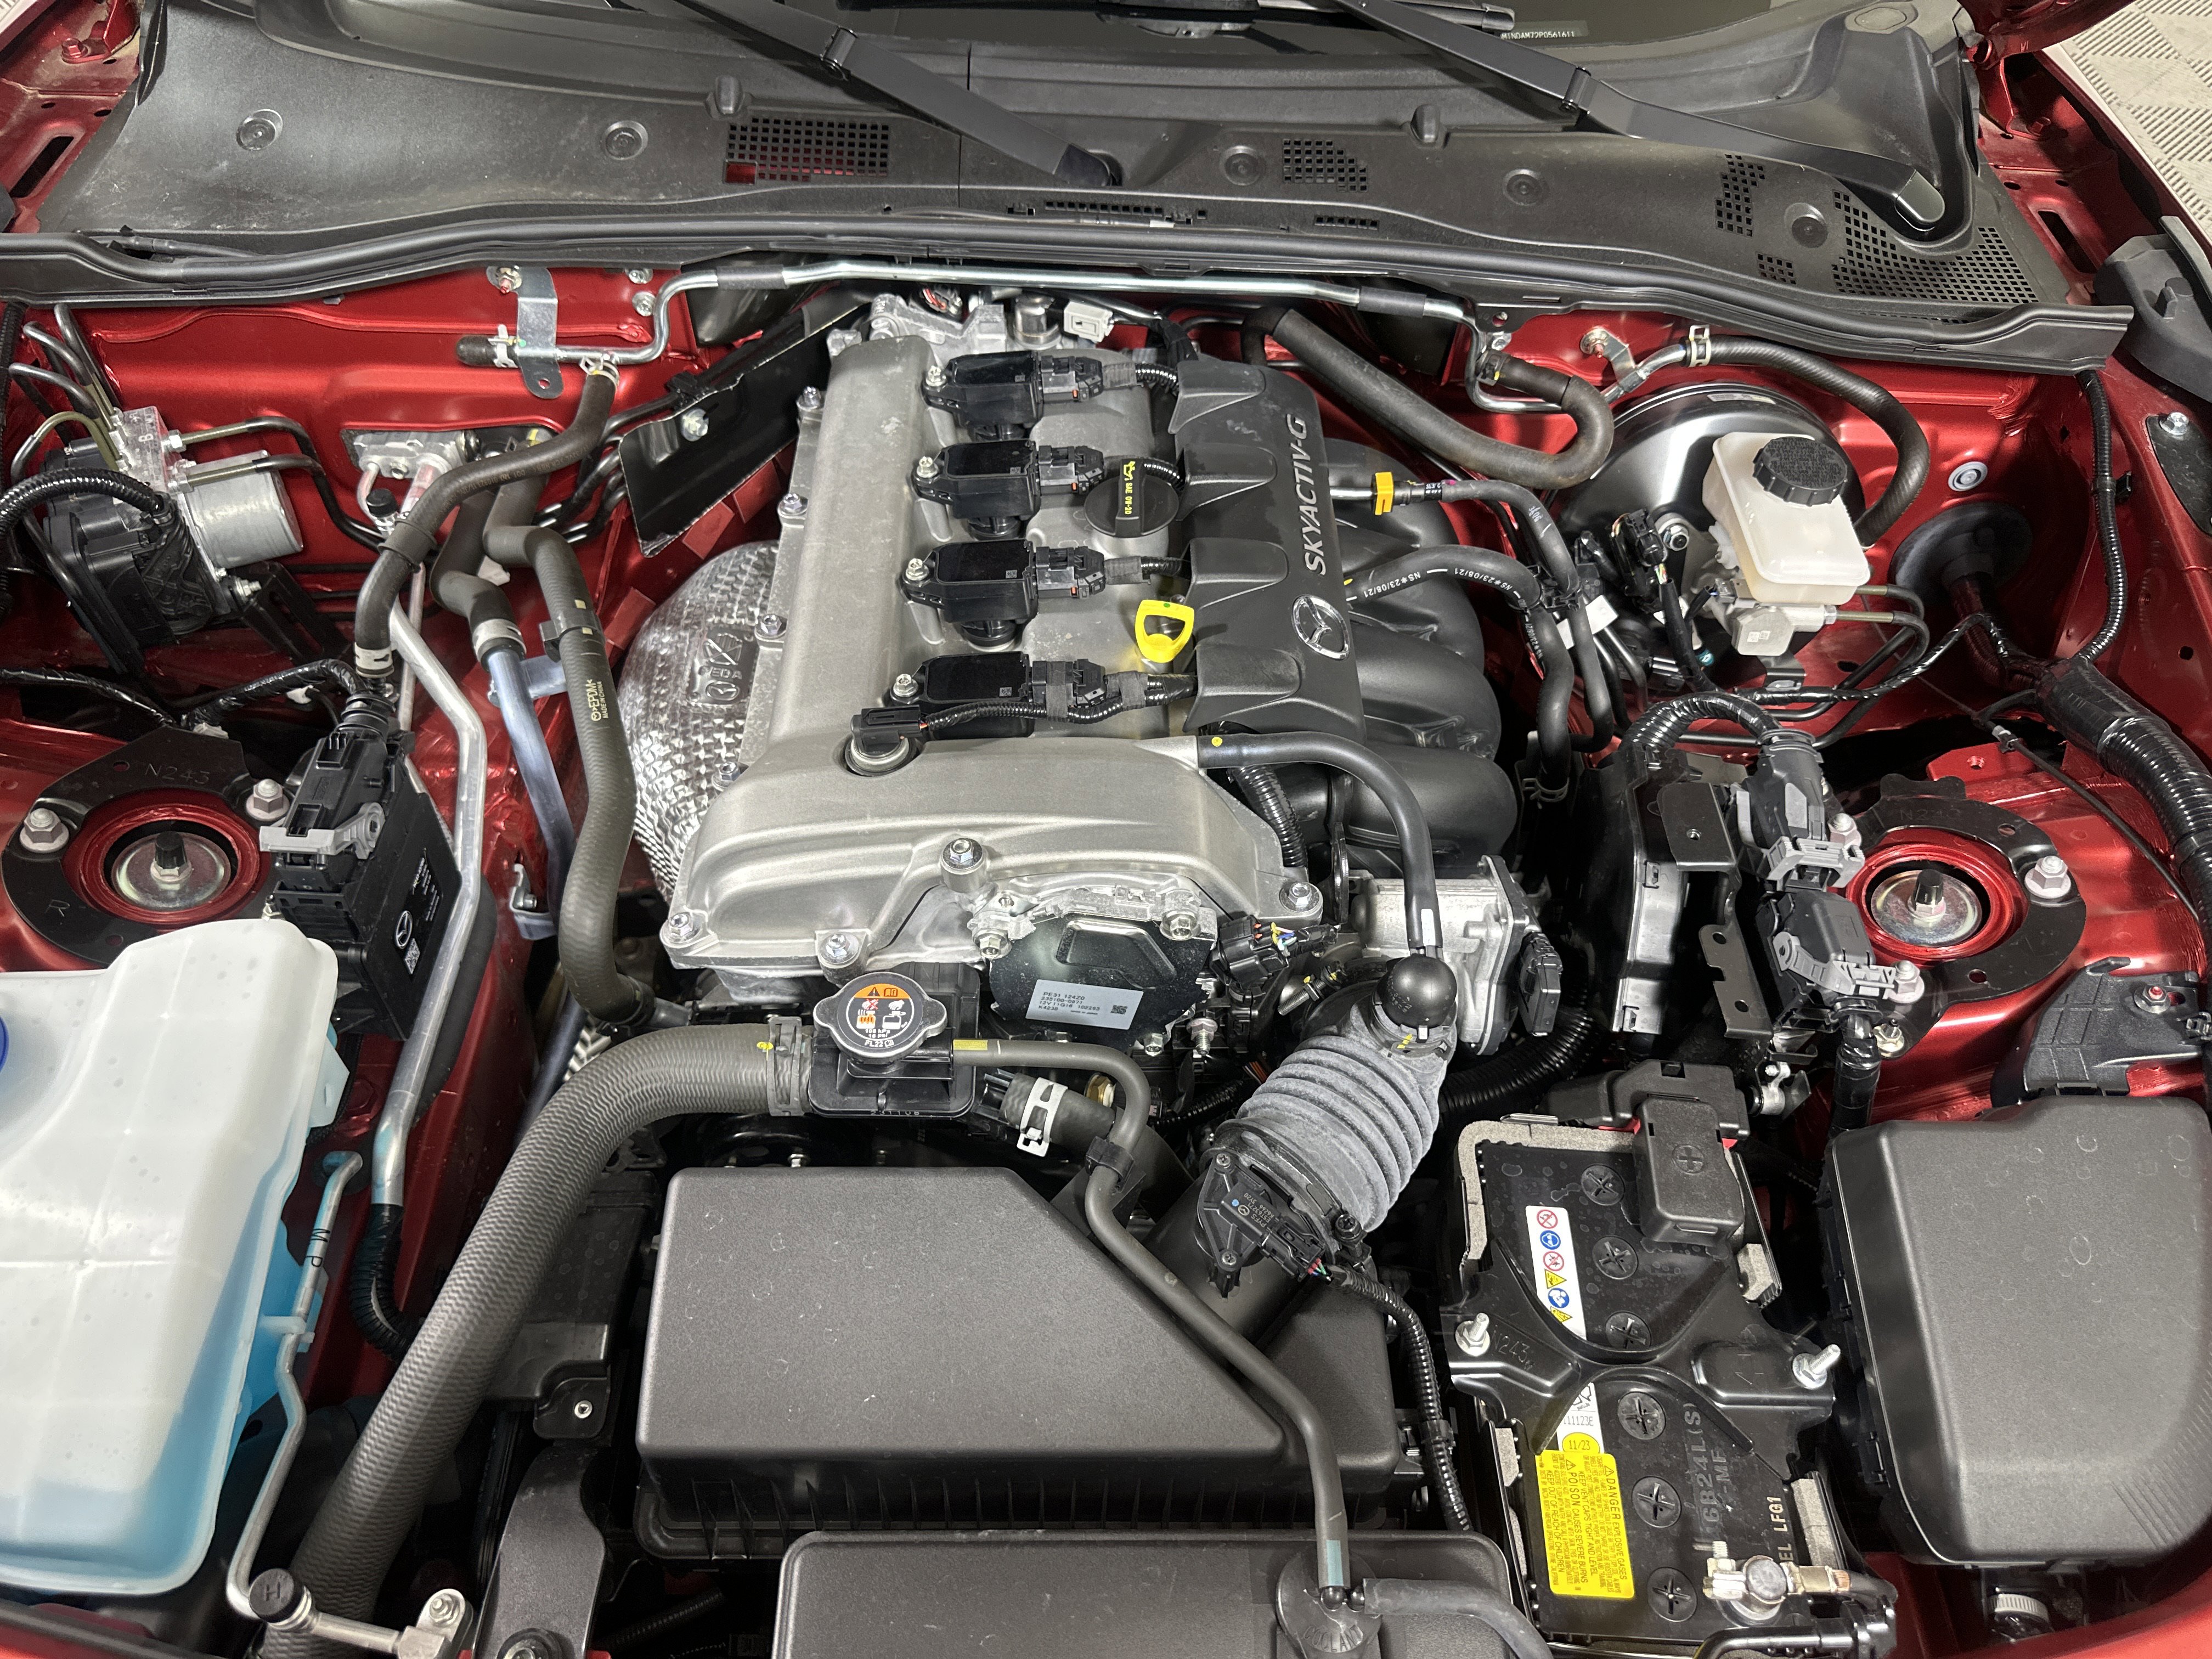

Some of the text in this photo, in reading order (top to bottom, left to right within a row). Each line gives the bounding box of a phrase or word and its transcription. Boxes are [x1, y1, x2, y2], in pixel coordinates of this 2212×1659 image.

[1286, 414, 1326, 576] SKYACTIV-G
[600, 703, 608, 718] MADE
[145, 763, 210, 785] N243
[1251, 1214, 1267, 1227] PYFS
[1569, 1440, 1590, 1450] 11/23
[1545, 1470, 1554, 1485] KEEP
[1548, 1487, 1556, 1498] OUT
[1550, 1510, 1560, 1530] REACH
[1567, 1472, 1588, 1583] POISON CAUSES SEVERE BURNS
[1577, 1471, 1598, 1576] KEEP VENT CAPS TIGHT AND LEVEL
[1606, 1478, 1627, 1579] DANGER EXPLOSIVE GASES
[1553, 1532, 1561, 1540] OF
[1554, 1542, 1565, 1572] CHILDREN
[1304, 1624, 1361, 1653] COOLANT
